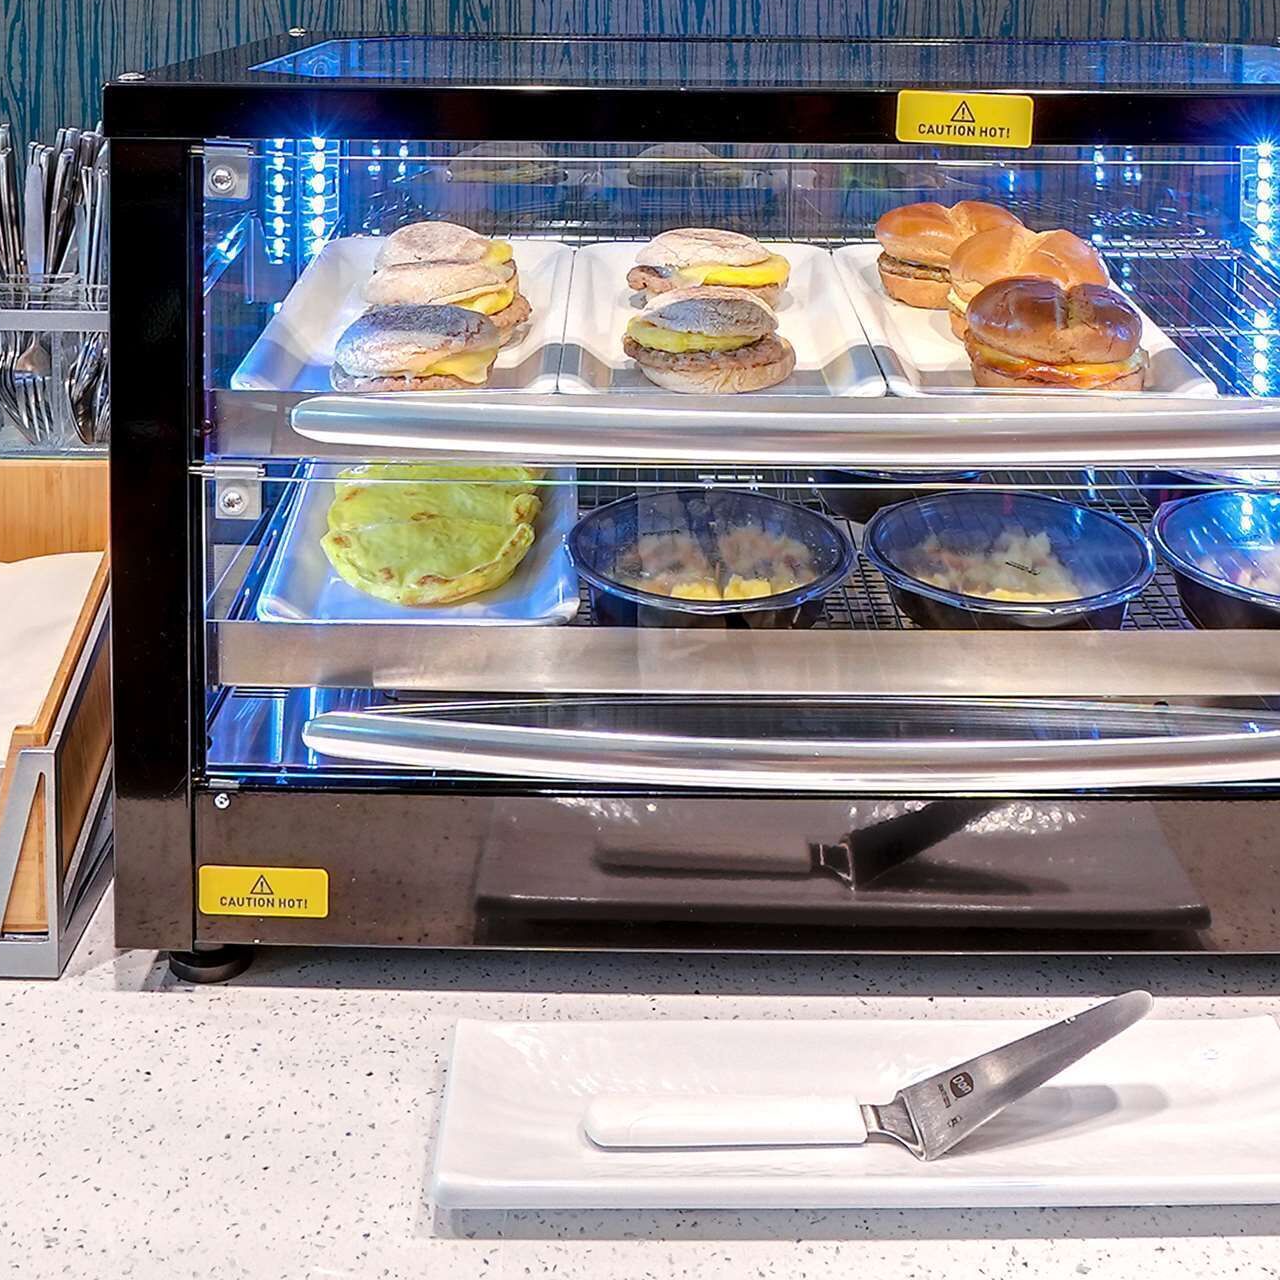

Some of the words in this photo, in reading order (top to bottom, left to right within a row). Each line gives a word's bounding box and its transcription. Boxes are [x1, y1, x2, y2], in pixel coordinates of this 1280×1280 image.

[918, 123, 975, 137] CAUTION
[979, 126, 1010, 139] HOT!
[220, 896, 275, 908] CAUTION
[278, 898, 308, 909] HOT!
[952, 1075, 972, 1094] Don
